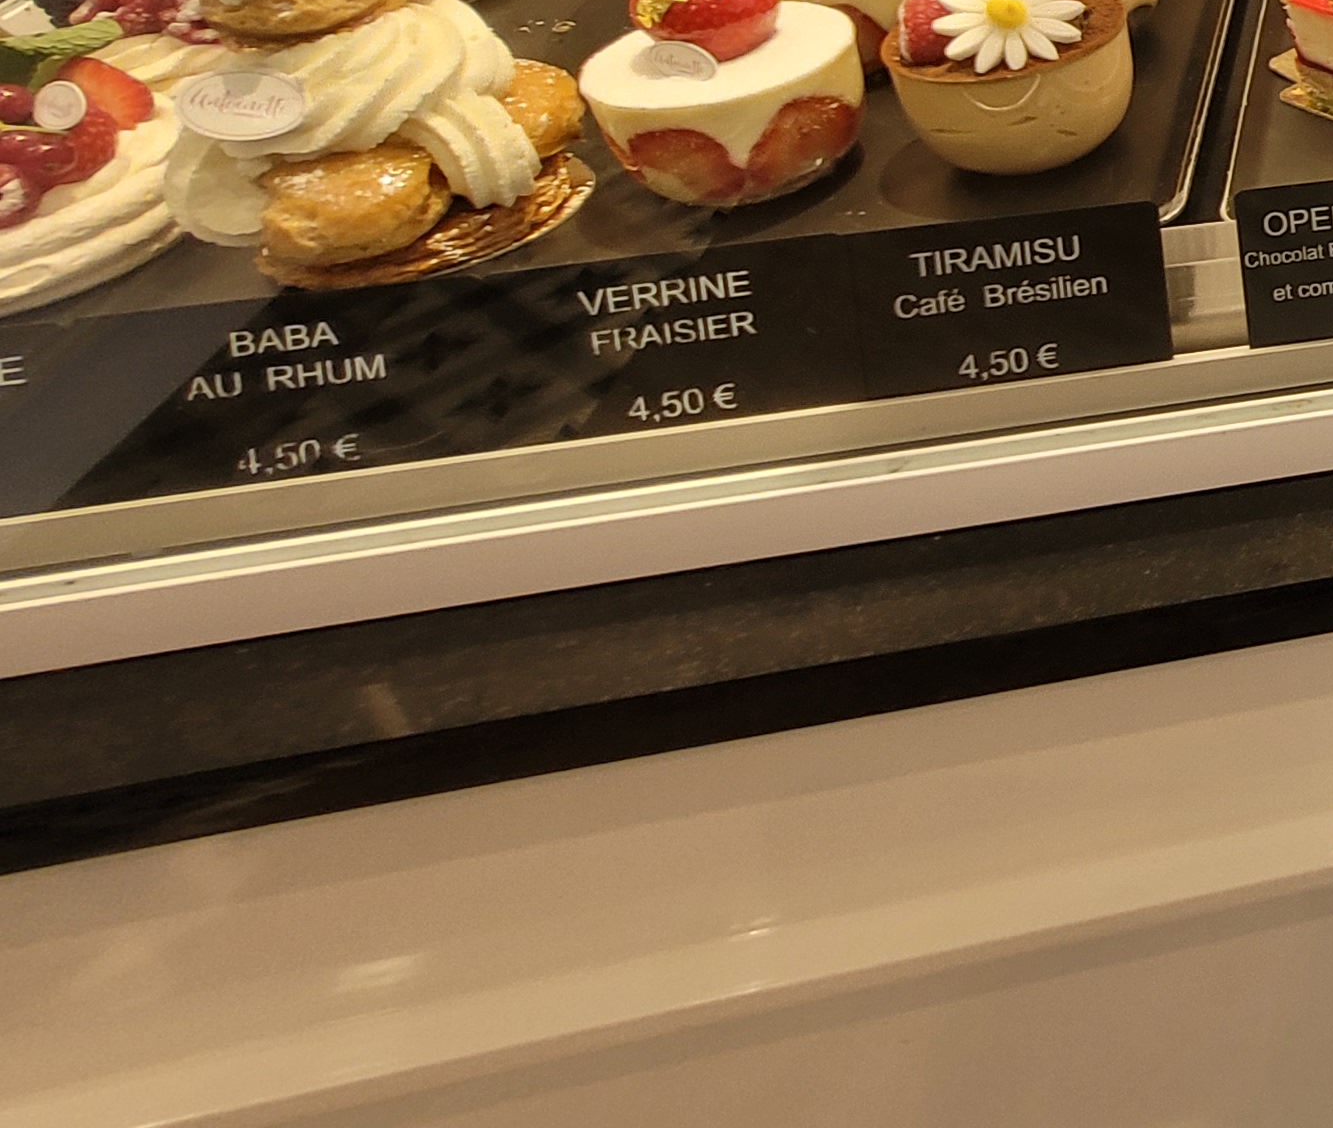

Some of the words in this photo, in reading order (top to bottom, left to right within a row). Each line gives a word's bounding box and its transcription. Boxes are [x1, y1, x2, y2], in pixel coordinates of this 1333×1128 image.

[909, 234, 1083, 279] TIRAMISU
[1244, 245, 1325, 270] Chocolat
[577, 270, 754, 317] VERRINE
[894, 284, 967, 320] Café
[984, 274, 1108, 309] Brésilien
[1273, 284, 1294, 302] et
[228, 320, 341, 359] BABA
[590, 309, 758, 356] FRAISIER
[186, 372, 243, 403] AU
[266, 353, 388, 393] RHUM
[958, 347, 1031, 382] 4,50
[1036, 343, 1060, 370] €
[628, 387, 705, 423] 4,50
[713, 382, 739, 411] €
[332, 433, 363, 463] €
